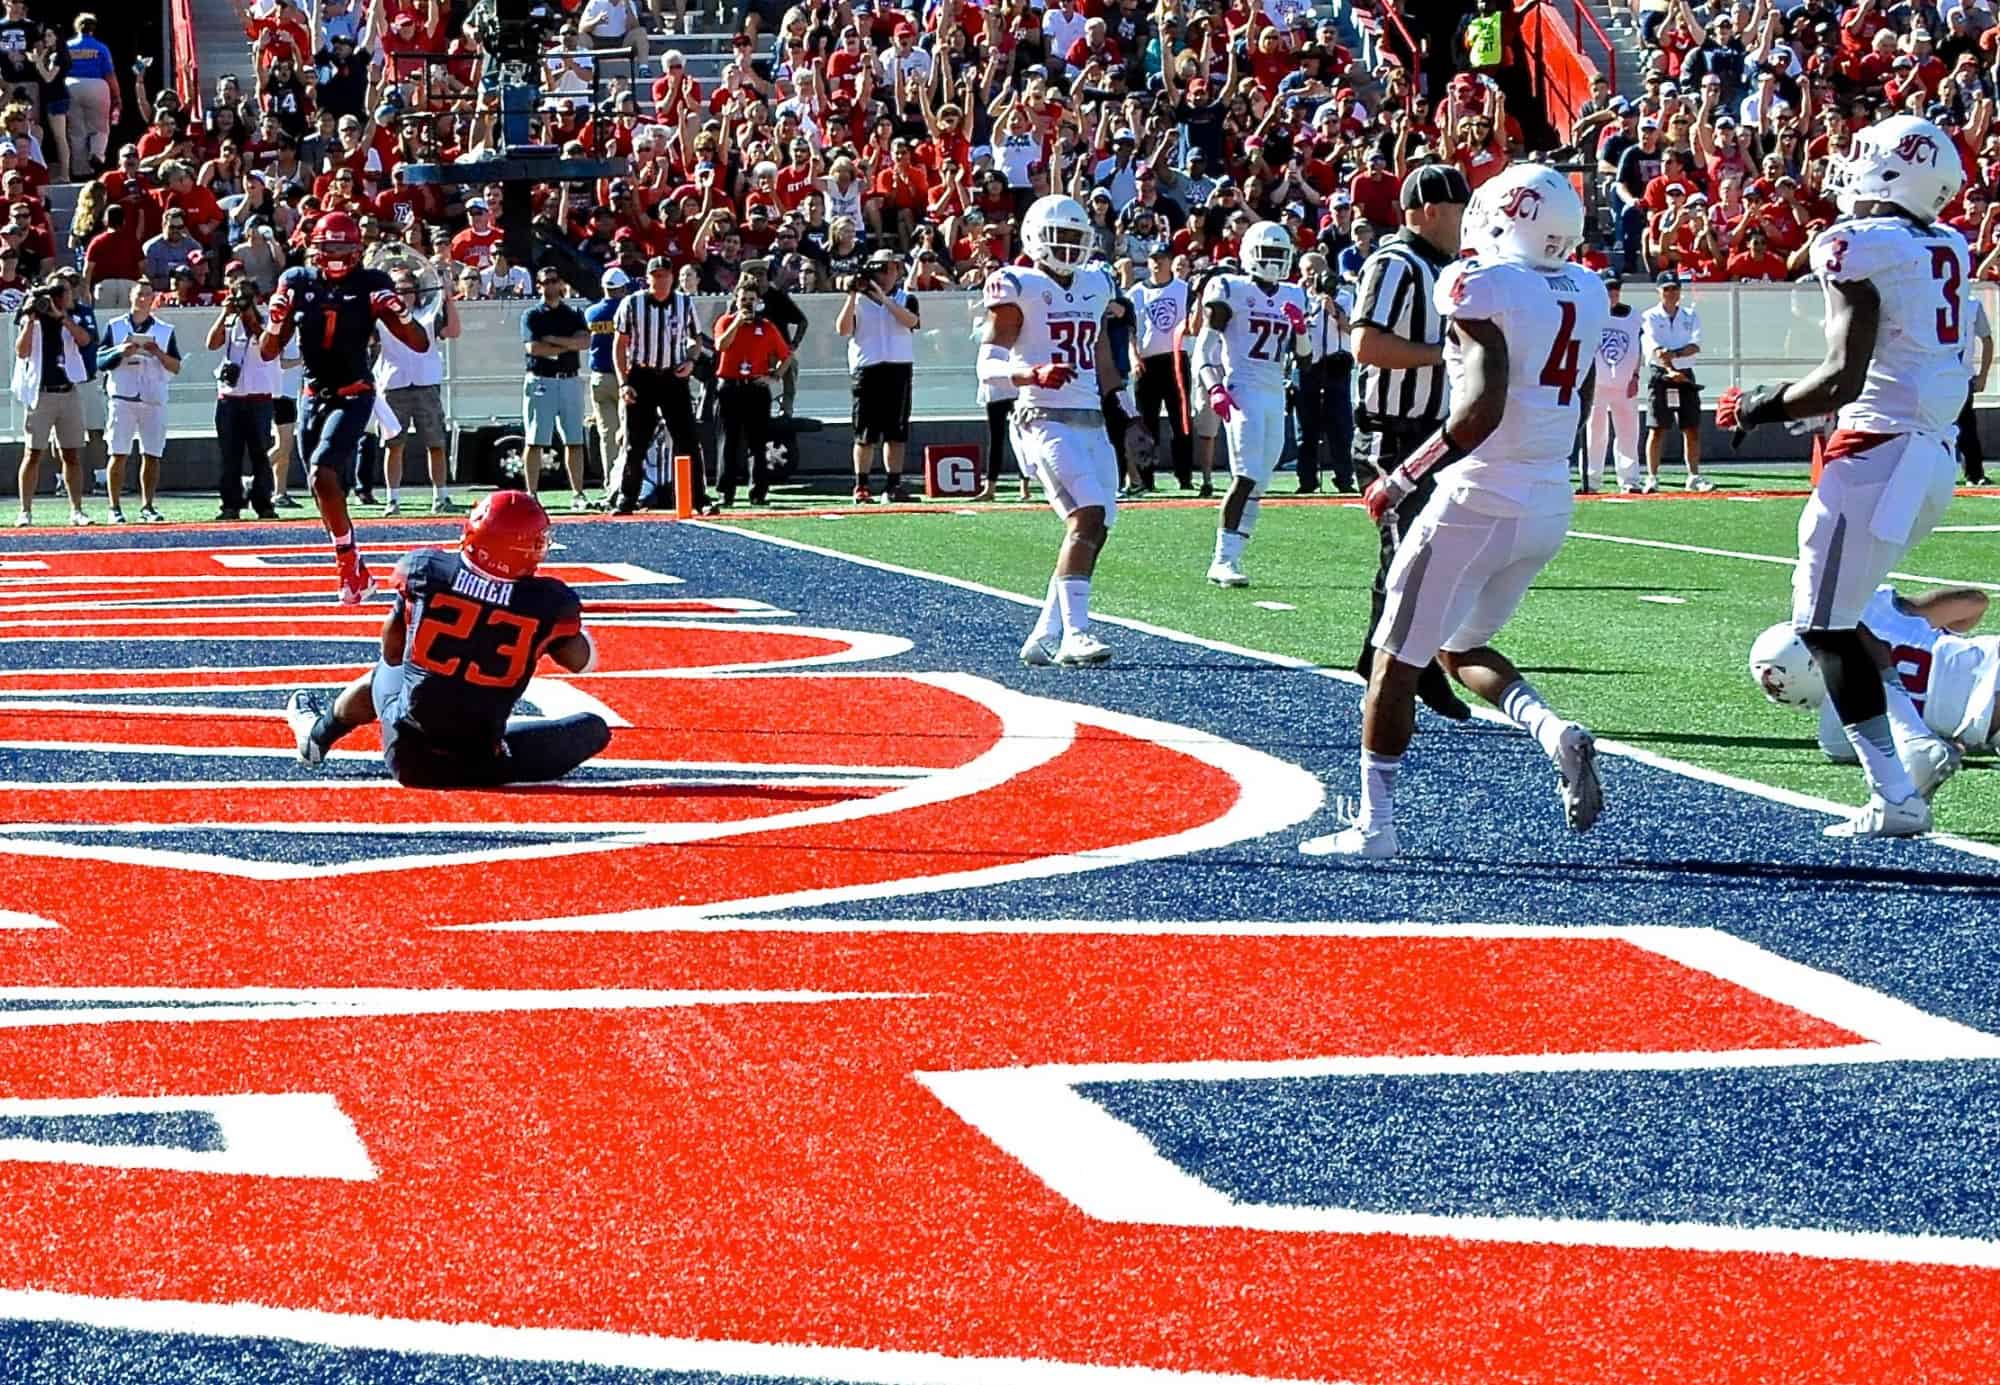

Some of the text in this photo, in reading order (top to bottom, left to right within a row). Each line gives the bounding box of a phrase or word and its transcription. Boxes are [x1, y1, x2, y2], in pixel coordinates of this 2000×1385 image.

[1826, 237, 1848, 273] 3
[1925, 245, 1961, 344] 3
[321, 309, 337, 350] 1
[1046, 320, 1097, 370] 30
[1248, 318, 1290, 362] 27
[1540, 300, 1581, 406] 4
[936, 456, 976, 493] G
[411, 592, 540, 688] 23
